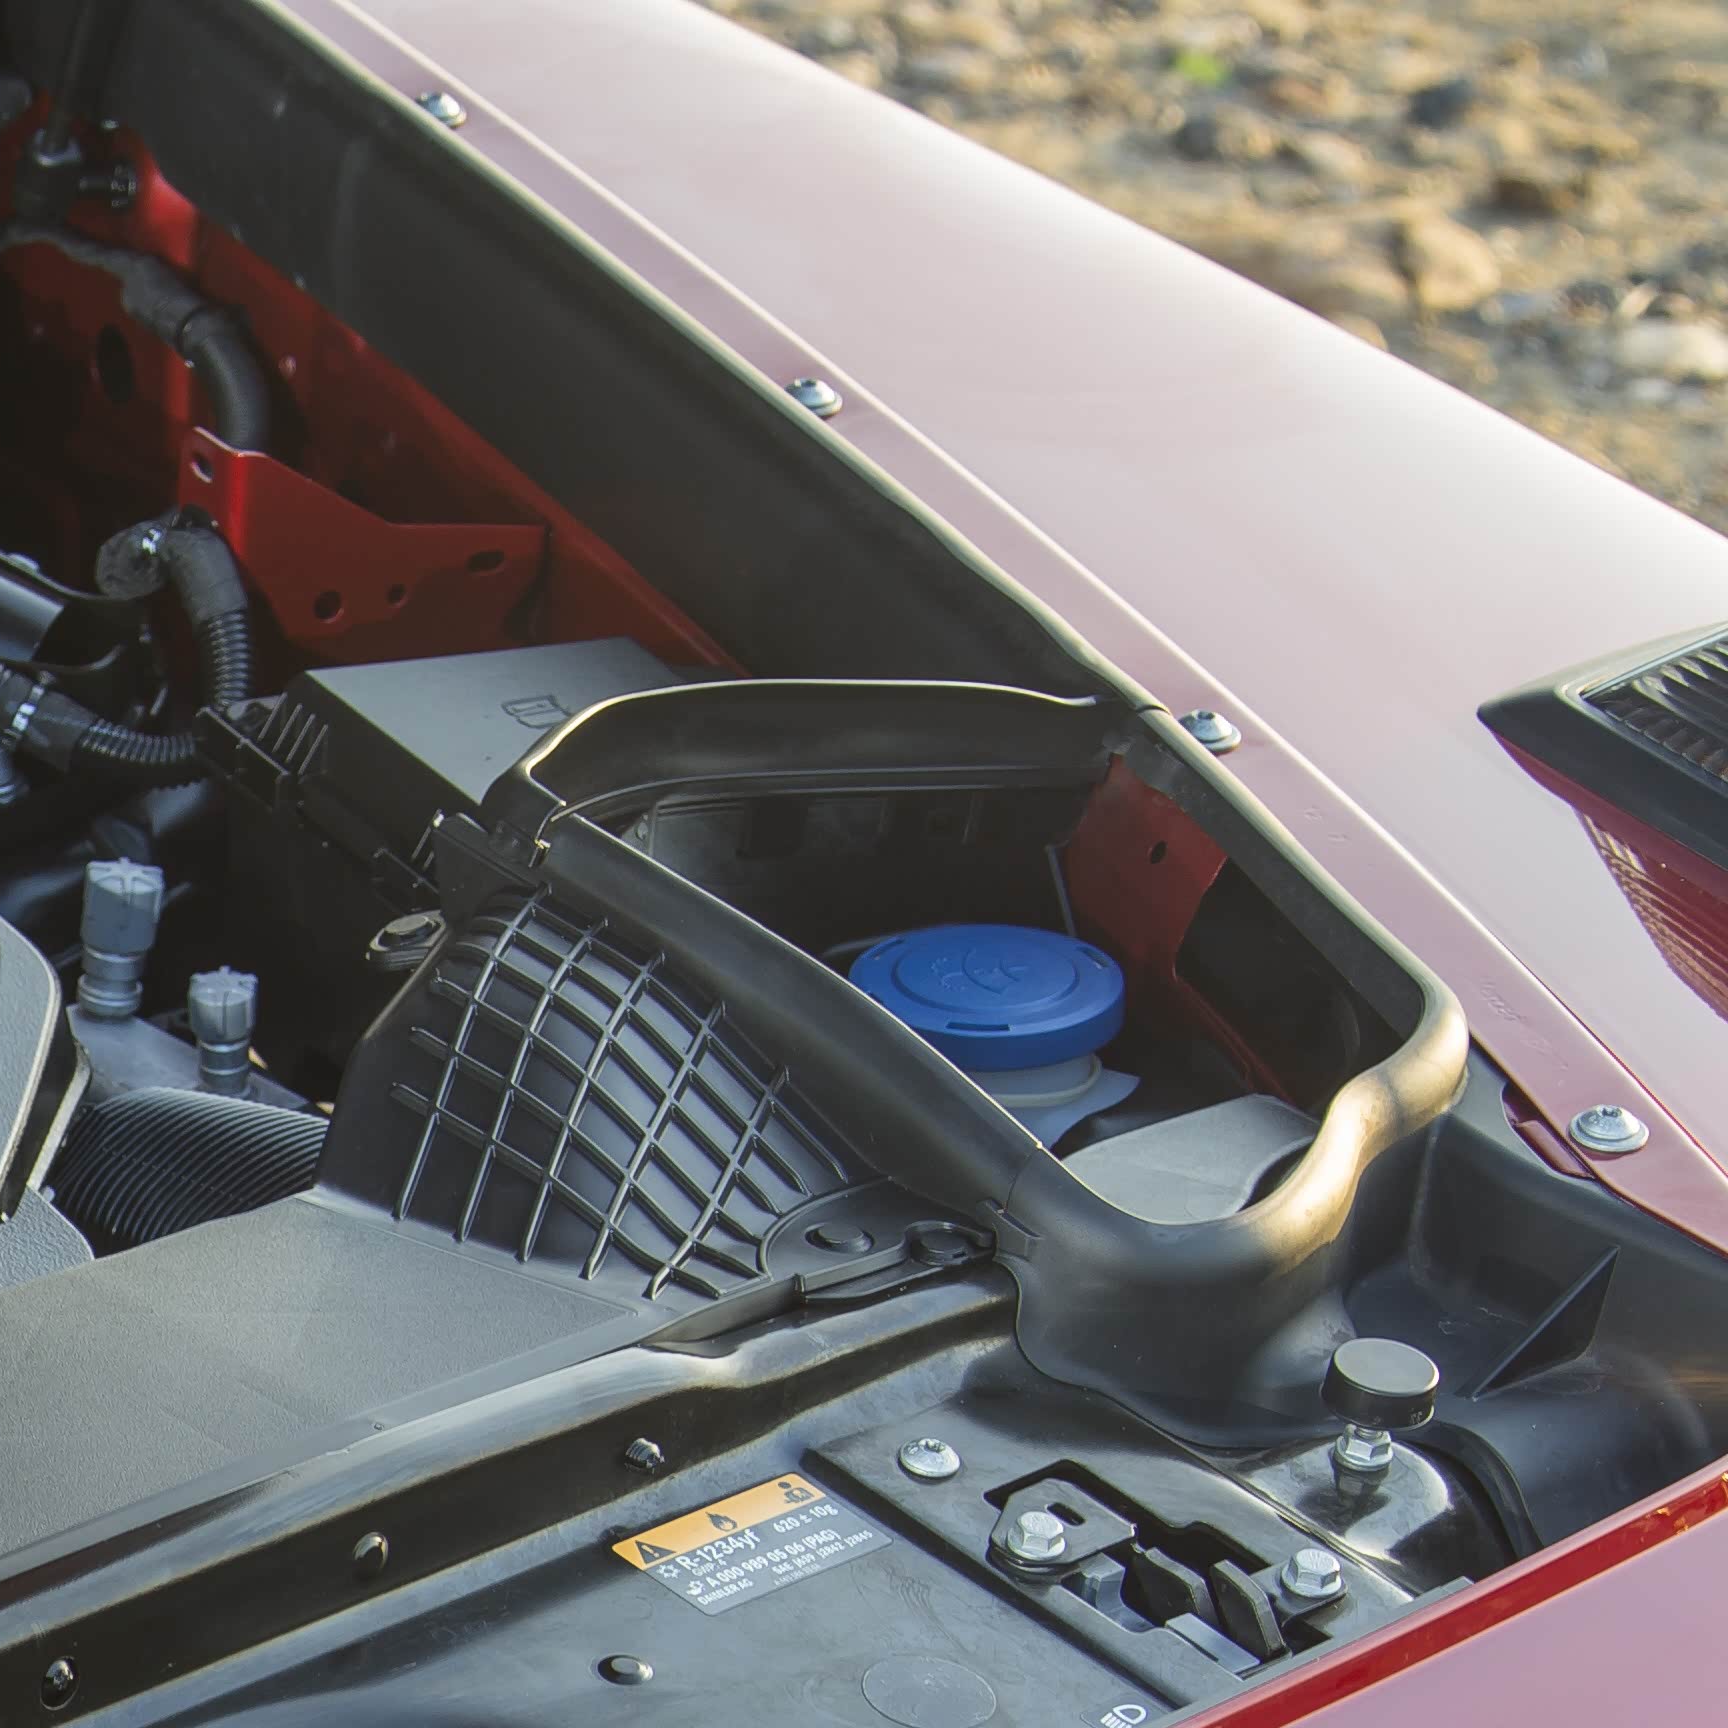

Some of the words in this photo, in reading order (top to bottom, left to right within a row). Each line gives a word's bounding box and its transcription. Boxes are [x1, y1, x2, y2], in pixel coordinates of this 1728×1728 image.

[674, 1528, 761, 1571] R-1234yf
[773, 1516, 801, 1533] 620
[808, 1503, 839, 1519] 10g
[705, 1576, 721, 1588] A
[715, 1566, 745, 1583] 000
[740, 1555, 769, 1573] 989
[766, 1548, 789, 1563] 05
[784, 1541, 806, 1556] 06
[801, 1528, 842, 1550] (PAG)
[771, 1561, 794, 1575] SAE
[696, 1583, 741, 1606] DAIMLER
[736, 1577, 755, 1590] AG
